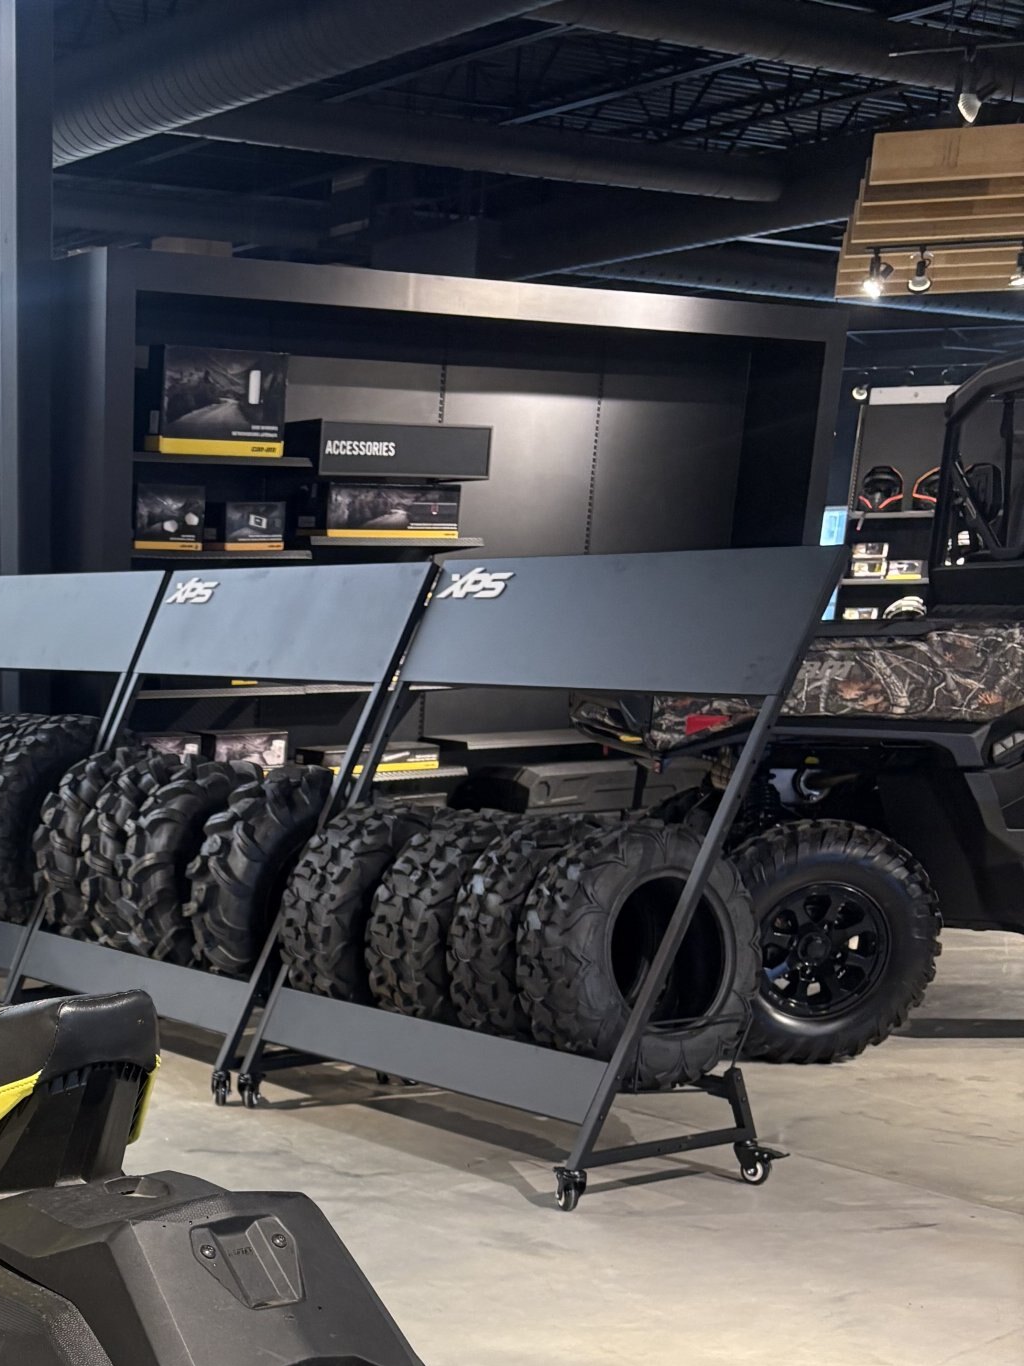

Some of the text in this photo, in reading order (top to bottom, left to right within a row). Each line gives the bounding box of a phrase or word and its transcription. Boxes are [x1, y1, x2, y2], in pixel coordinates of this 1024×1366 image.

[325, 439, 396, 457] ACCESSORIES
[166, 577, 219, 604] XPS
[436, 567, 514, 599] XPS
